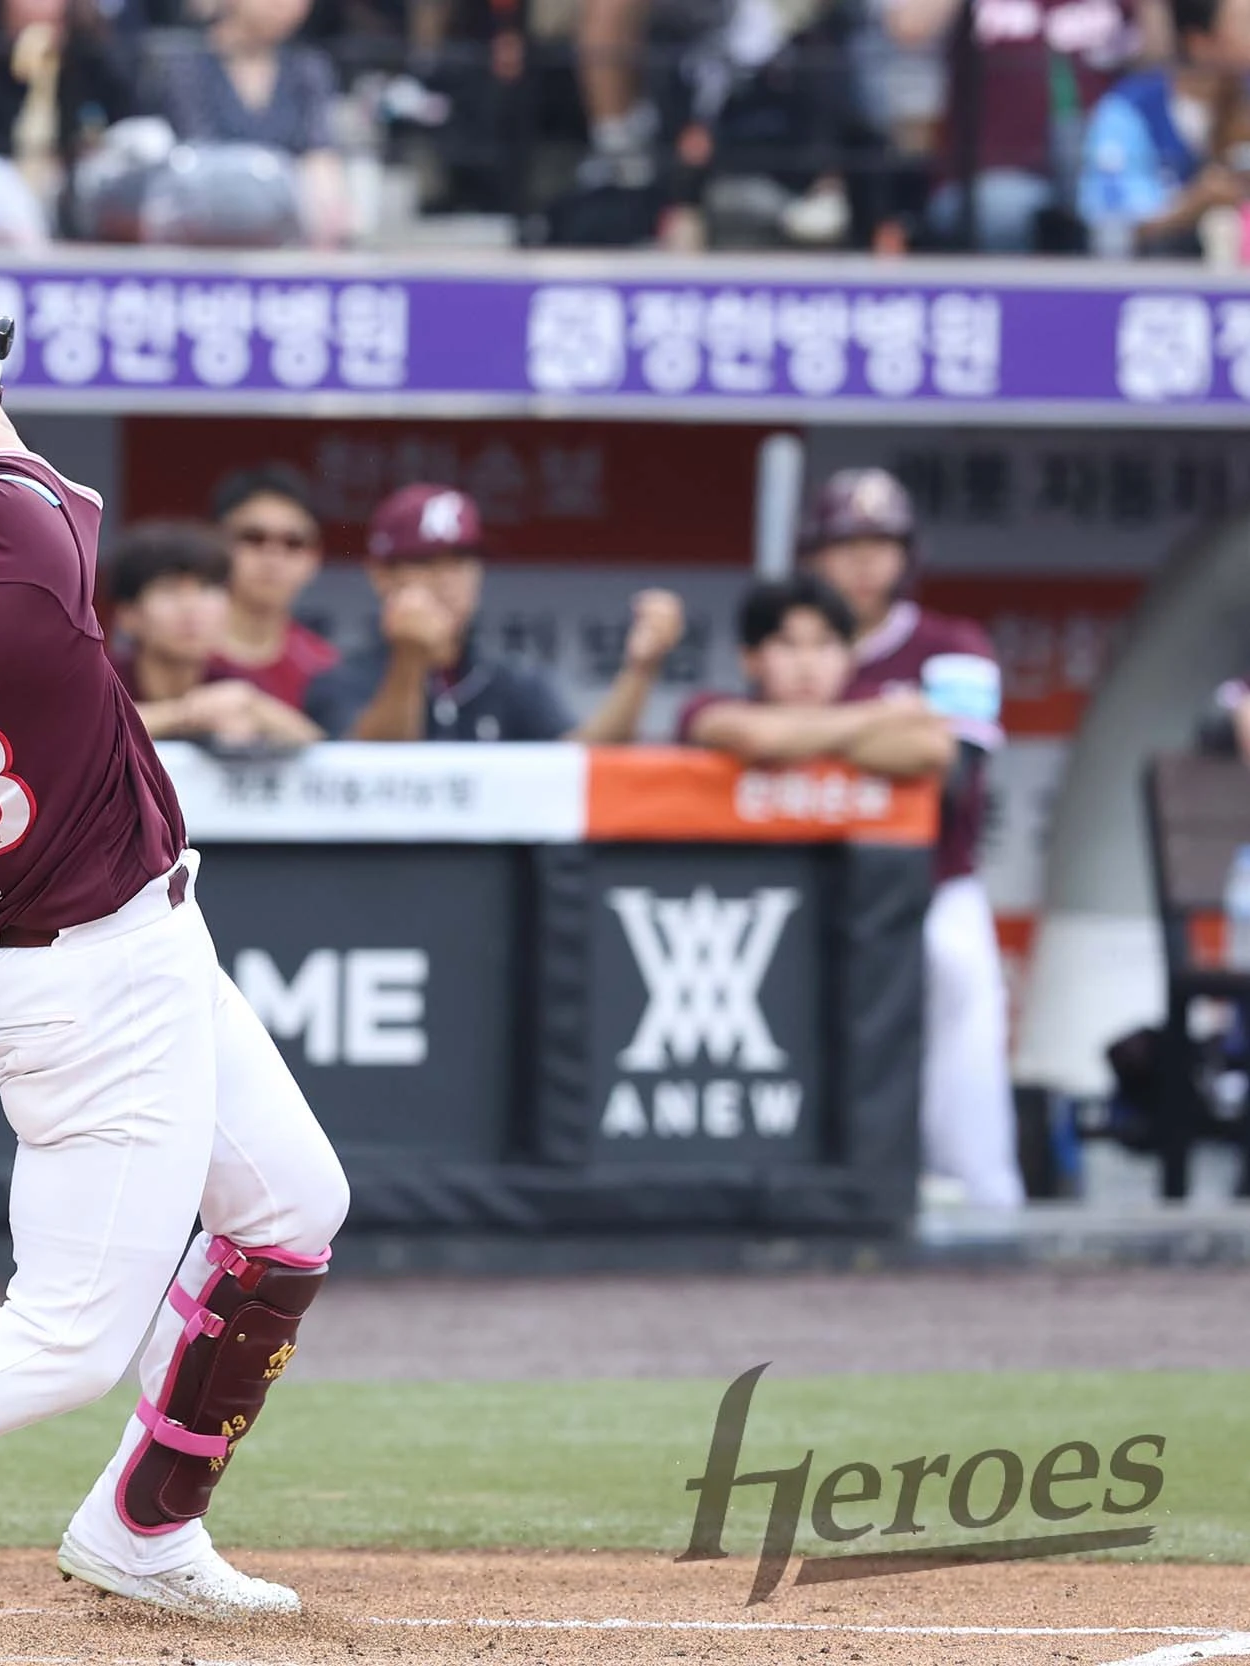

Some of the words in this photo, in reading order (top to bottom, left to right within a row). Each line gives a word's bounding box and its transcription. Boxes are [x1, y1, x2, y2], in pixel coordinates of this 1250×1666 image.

[30, 278, 410, 387] 정한방병원
[600, 1079, 803, 1139] ANEW
[221, 1414, 247, 1437] 43
